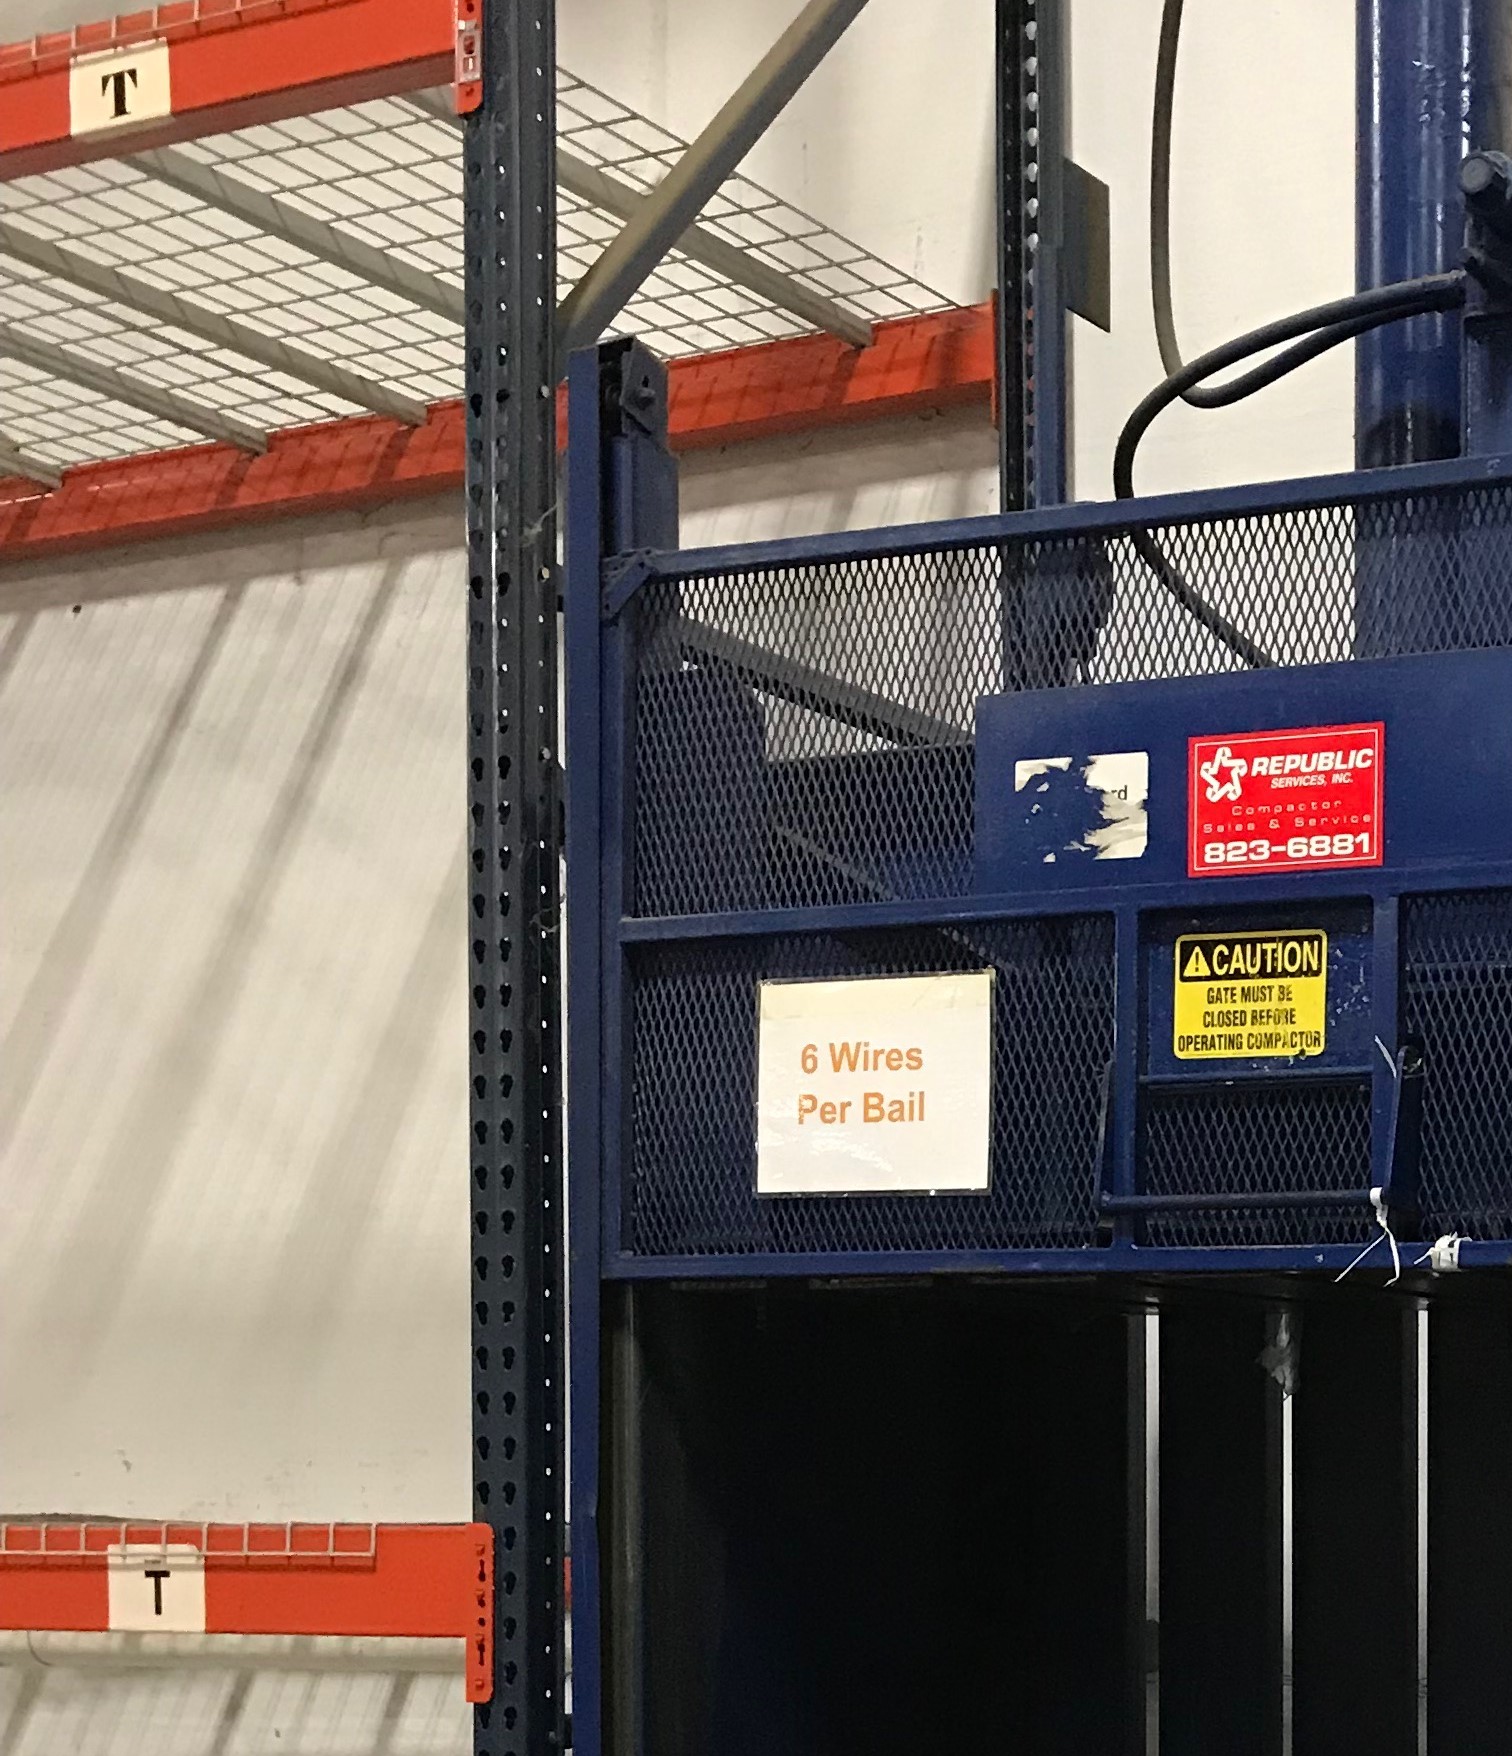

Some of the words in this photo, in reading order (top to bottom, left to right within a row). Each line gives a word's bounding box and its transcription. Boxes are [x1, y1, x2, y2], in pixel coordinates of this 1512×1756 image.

[101, 67, 138, 119] T
[1251, 748, 1374, 777] REPUBLIC
[1270, 774, 1328, 789] SERVICES,
[1331, 772, 1354, 784] INC.
[1231, 800, 1343, 817] Compactor
[1203, 822, 1256, 834] Sales
[1269, 818, 1281, 830] &
[1294, 813, 1372, 828] Service
[1203, 832, 1371, 864] 823-6881
[1212, 940, 1320, 976] CAUTION
[1206, 986, 1238, 1005] GATE
[1240, 985, 1275, 1004] MUST
[1277, 984, 1294, 1002] BE
[1202, 1010, 1247, 1028] CLOSED
[1250, 1007, 1297, 1027] BEFORE
[1177, 1033, 1244, 1053] OPERATING
[1246, 1030, 1322, 1051] COMPACTOR
[800, 1043, 819, 1075] 6
[828, 1041, 924, 1073] Wires
[798, 1093, 852, 1125] Per
[862, 1091, 926, 1124] Bail
[144, 1568, 171, 1616] T
